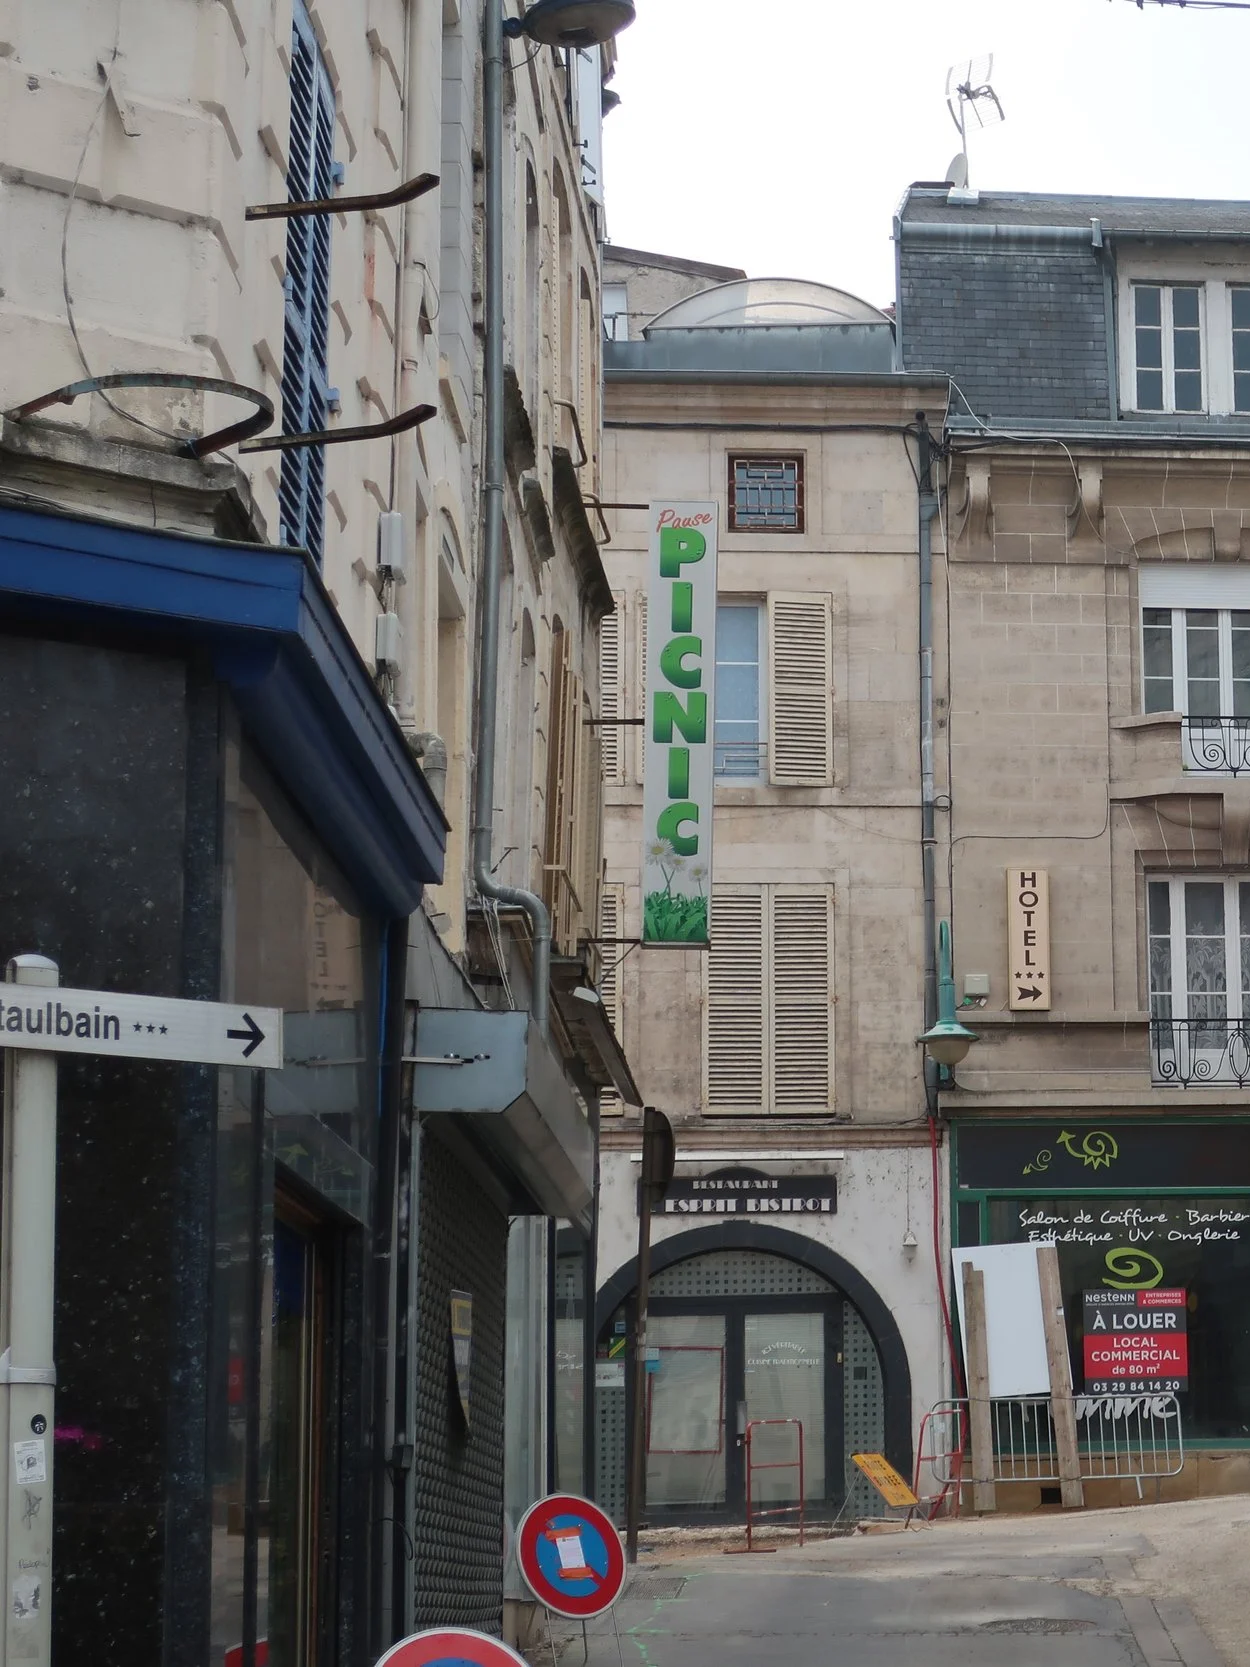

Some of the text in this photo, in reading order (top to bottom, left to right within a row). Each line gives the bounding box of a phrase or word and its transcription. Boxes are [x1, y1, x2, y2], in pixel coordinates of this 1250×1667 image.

[656, 509, 712, 532] Pause
[653, 527, 707, 856] PICNIC
[1019, 872, 1039, 966] HOTEL
[693, 1180, 779, 1190] RESTAURANT
[651, 1198, 832, 1213] ESPRIT BISTROT
[1019, 1208, 1250, 1227] Salon de Coiffure Barbier
[1028, 1226, 1241, 1246] Esthétique UV Onglerie
[1093, 1310, 1177, 1330] À LOUER
[1113, 1337, 1158, 1348] LOCAL
[1091, 1350, 1180, 1361] COMMERCIAL
[1112, 1365, 1125, 1375] de
[1129, 1365, 1143, 1375] 80
[1093, 1381, 1180, 1392] 03 29 84 14 20
